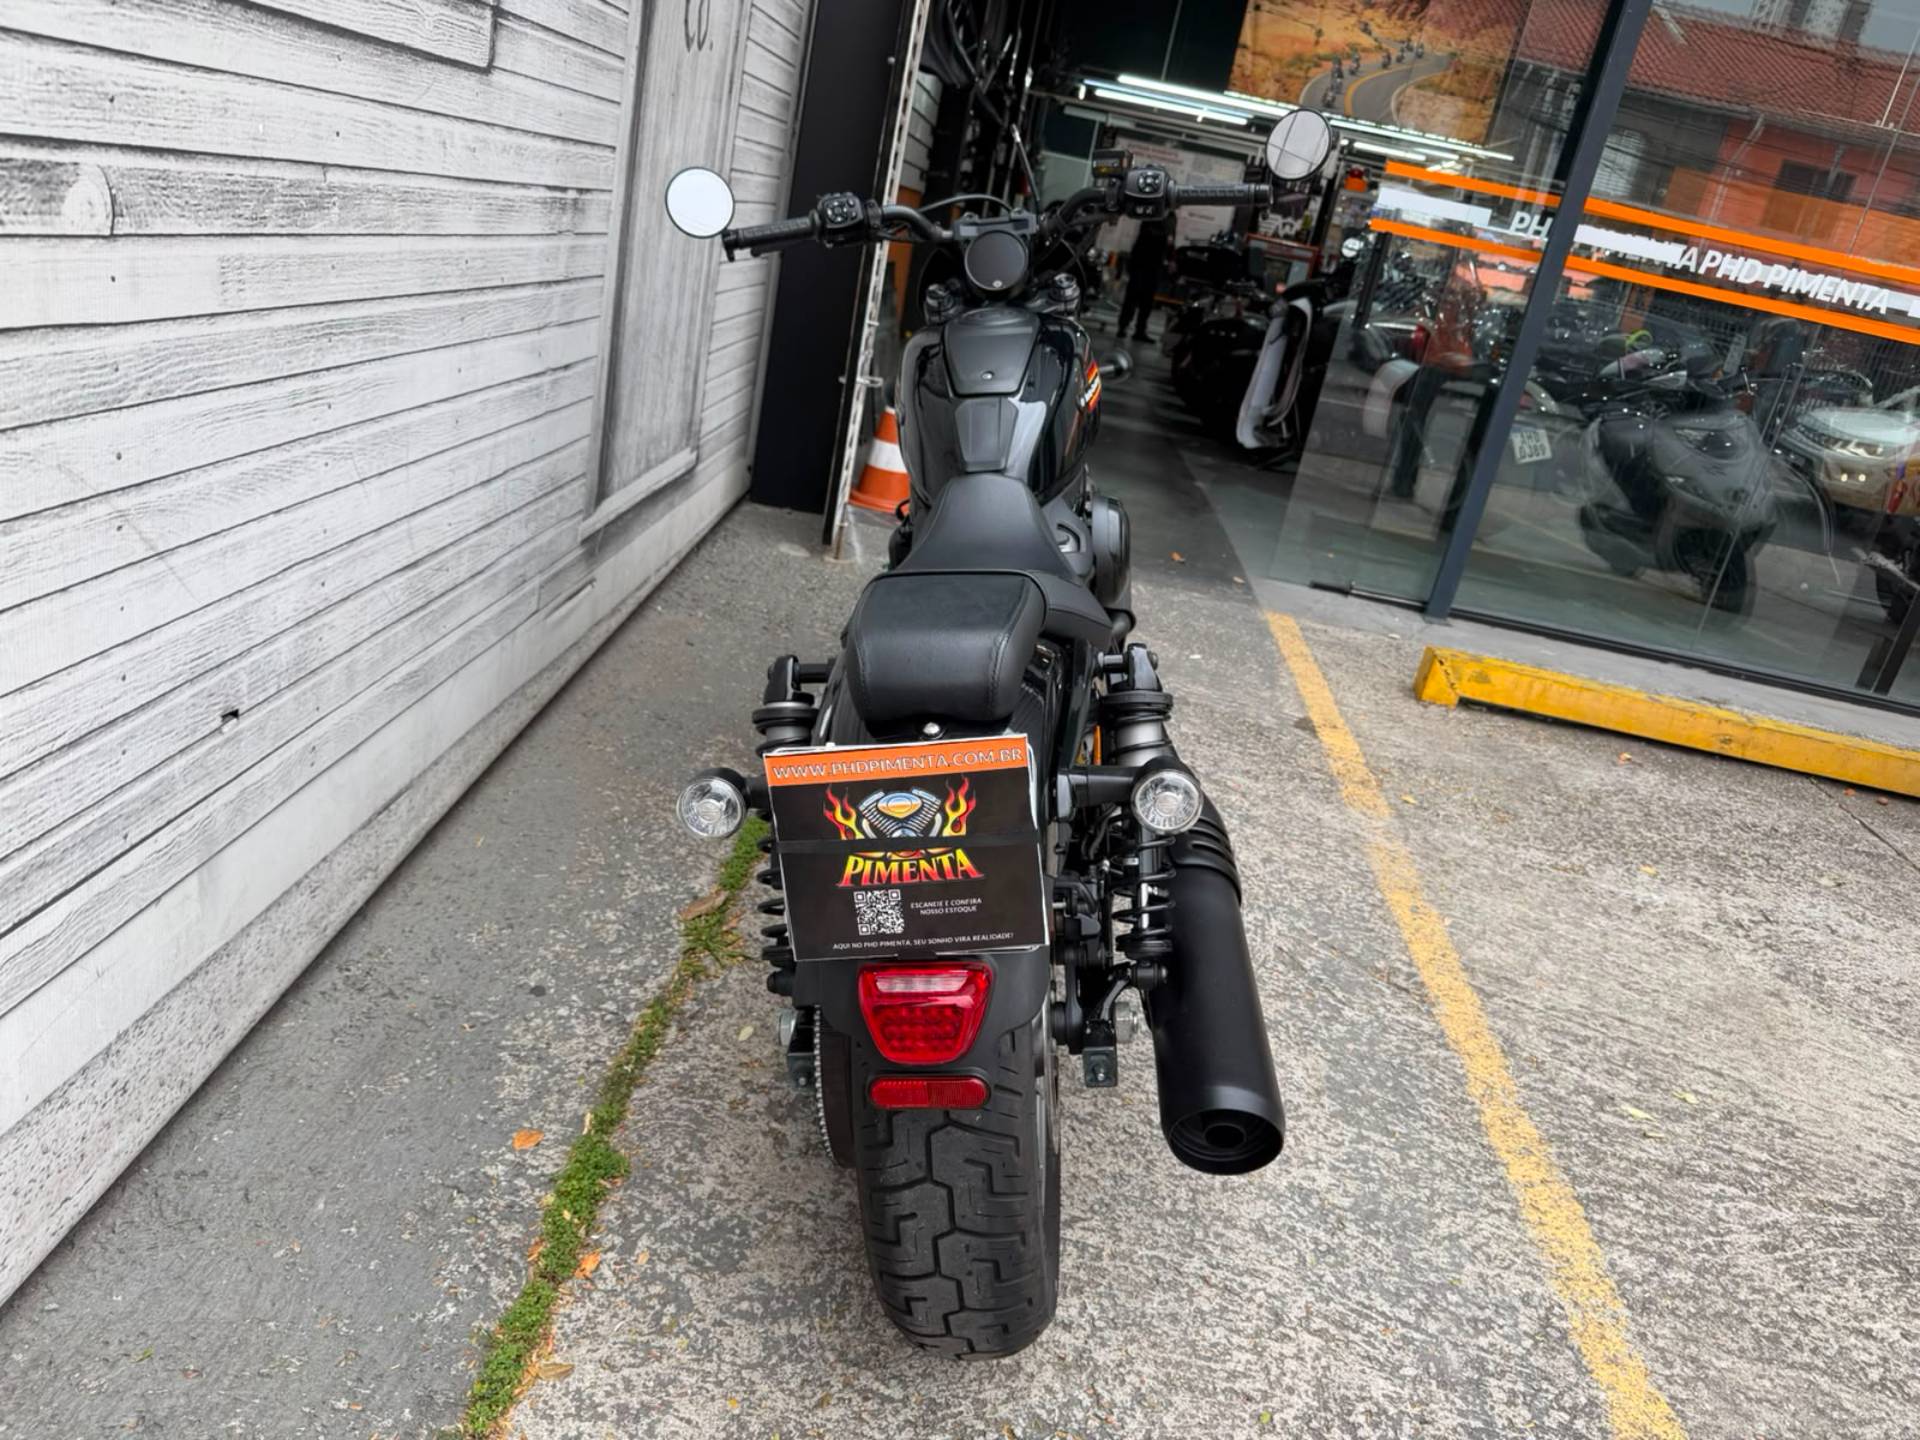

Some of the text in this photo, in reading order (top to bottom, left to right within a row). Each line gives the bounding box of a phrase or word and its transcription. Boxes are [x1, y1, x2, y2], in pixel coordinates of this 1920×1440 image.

[1509, 210, 1554, 240] PH
[1698, 249, 1762, 284] PHD
[1762, 263, 1890, 314] PIMENTA
[772, 748, 1025, 779] WWW.PHDPIMENTA.COM.BR
[835, 848, 985, 888] PIMENTA
[910, 900, 944, 910] ESCANEIE
[950, 897, 983, 907] CONFIRA
[920, 904, 978, 916] NOSSO ESTOQUE
[832, 942, 850, 950] AQUI
[851, 941, 862, 949] NO
[863, 940, 879, 949] PHD
[913, 938, 927, 946] SEU
[928, 936, 953, 946] SONHO
[954, 935, 971, 944] VIRA
